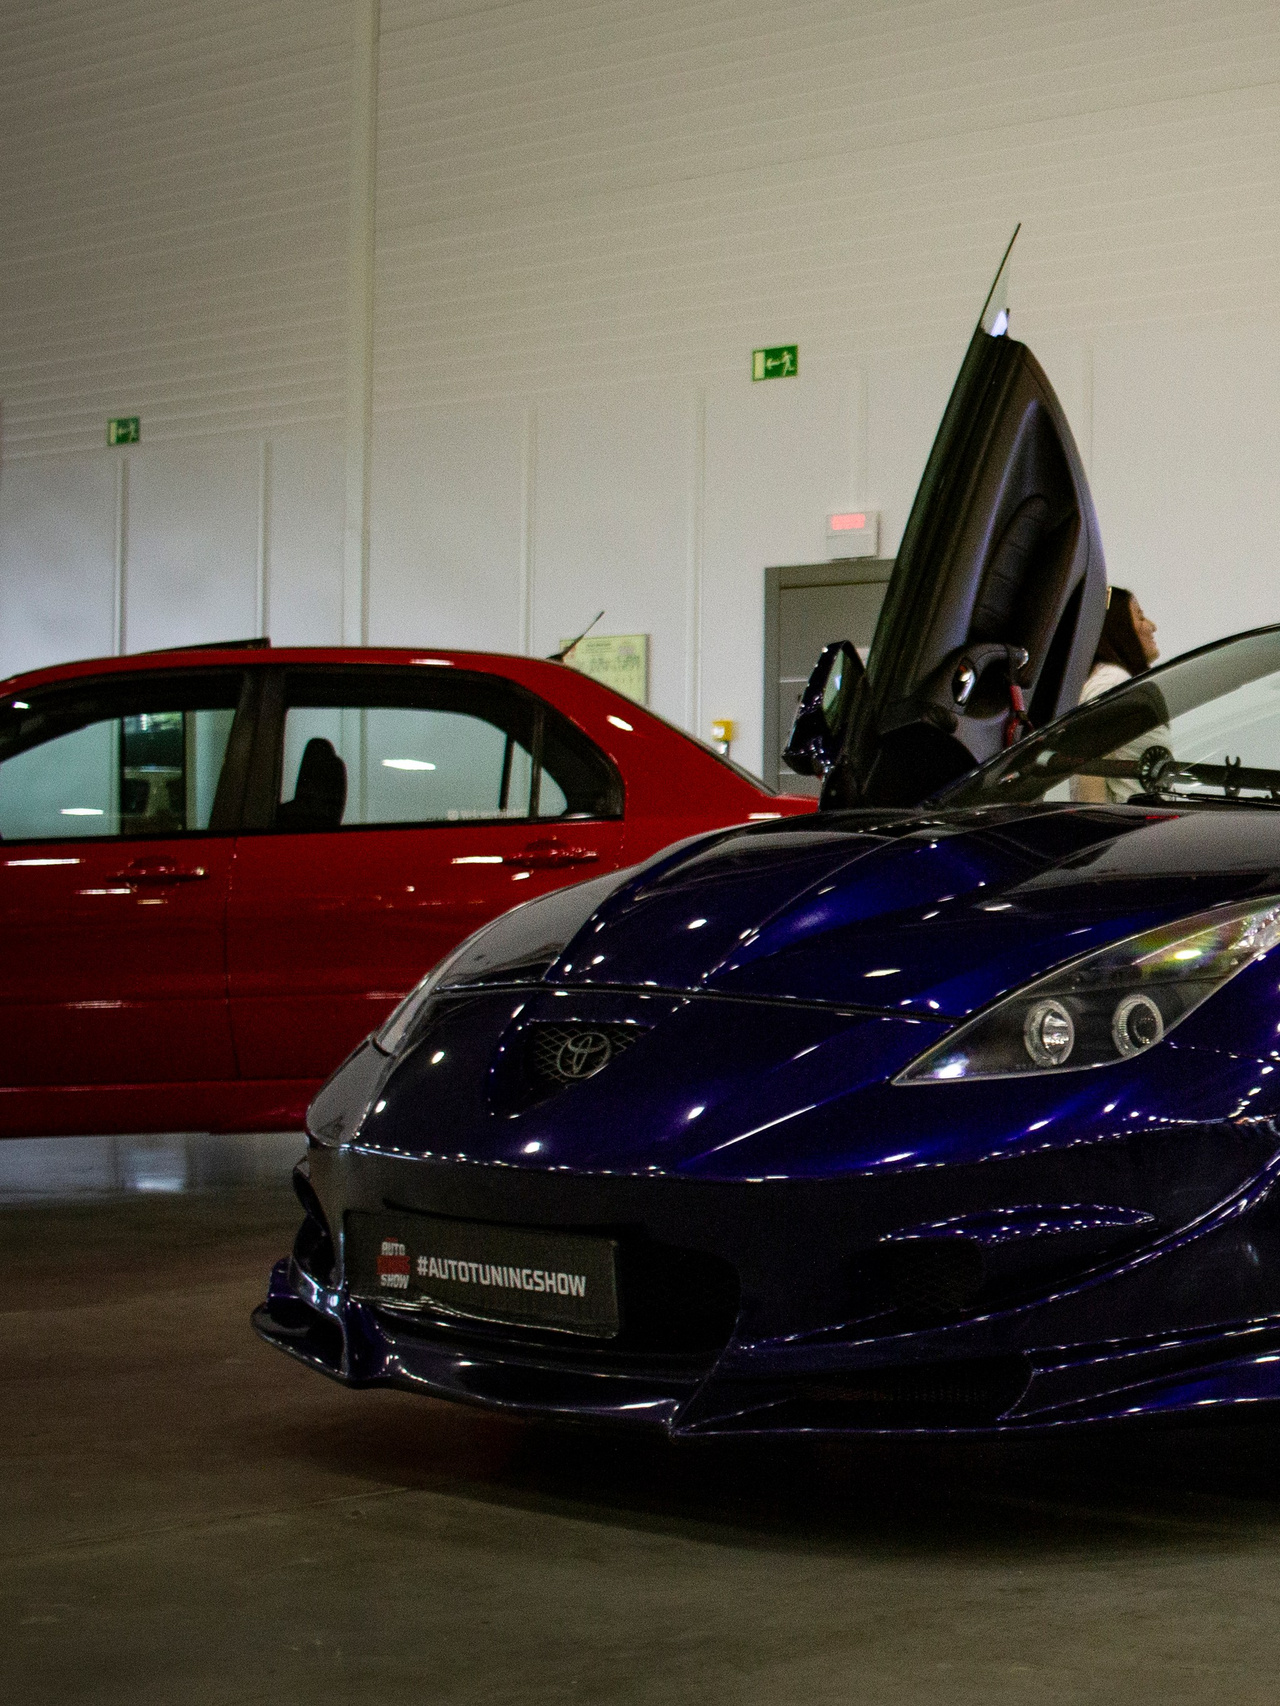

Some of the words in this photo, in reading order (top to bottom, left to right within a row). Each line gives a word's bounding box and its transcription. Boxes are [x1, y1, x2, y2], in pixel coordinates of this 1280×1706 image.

[381, 1241, 406, 1256] AUTO
[380, 1274, 410, 1289] SHOW
[417, 1256, 587, 1297] #AUTOTUNINGSHOW
